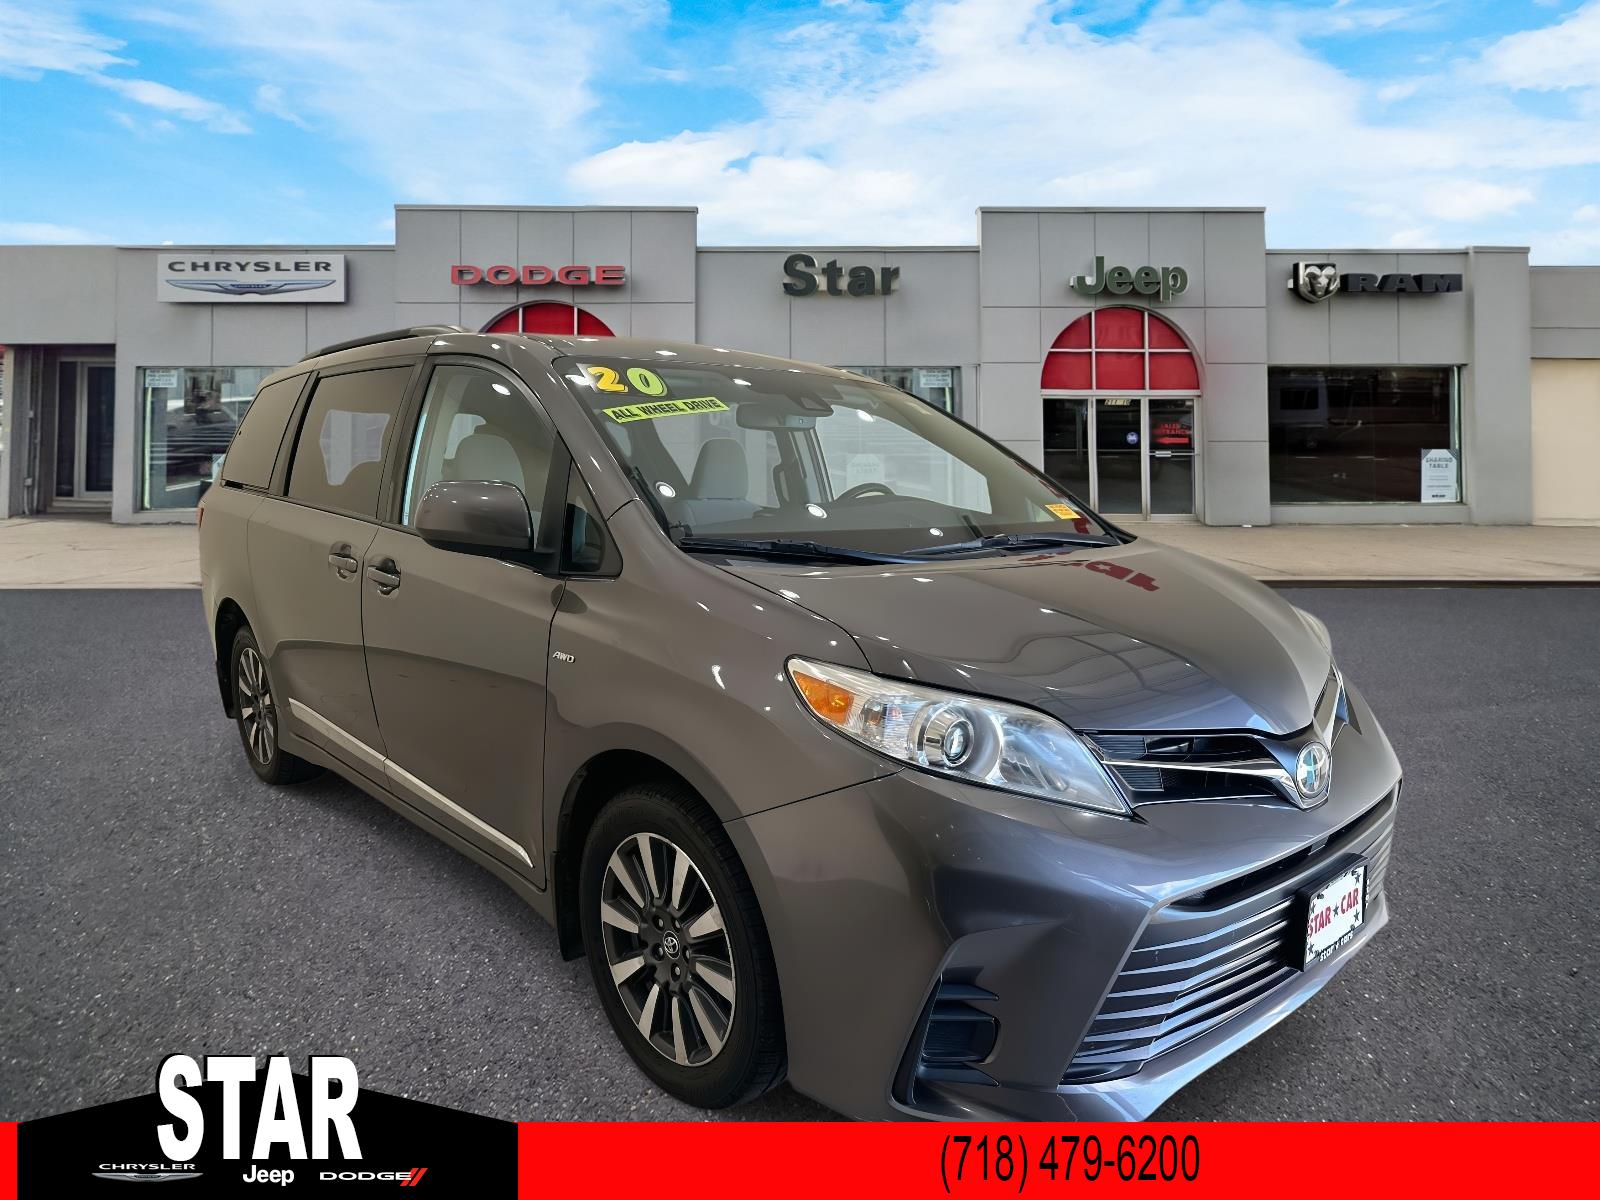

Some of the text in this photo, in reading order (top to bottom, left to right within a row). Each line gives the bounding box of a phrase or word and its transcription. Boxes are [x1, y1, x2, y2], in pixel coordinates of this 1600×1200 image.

[168, 261, 332, 272] CHRYSLER
[450, 264, 626, 286] DODGE
[783, 253, 901, 297] Star
[1070, 255, 1189, 301] Jeep
[1350, 273, 1463, 293] RAM
[587, 366, 668, 397] 20
[611, 398, 723, 420] ALL WHEEL DRIVE
[552, 651, 575, 663] AWD
[1307, 905, 1332, 939] STAR
[1340, 887, 1359, 915] CAR
